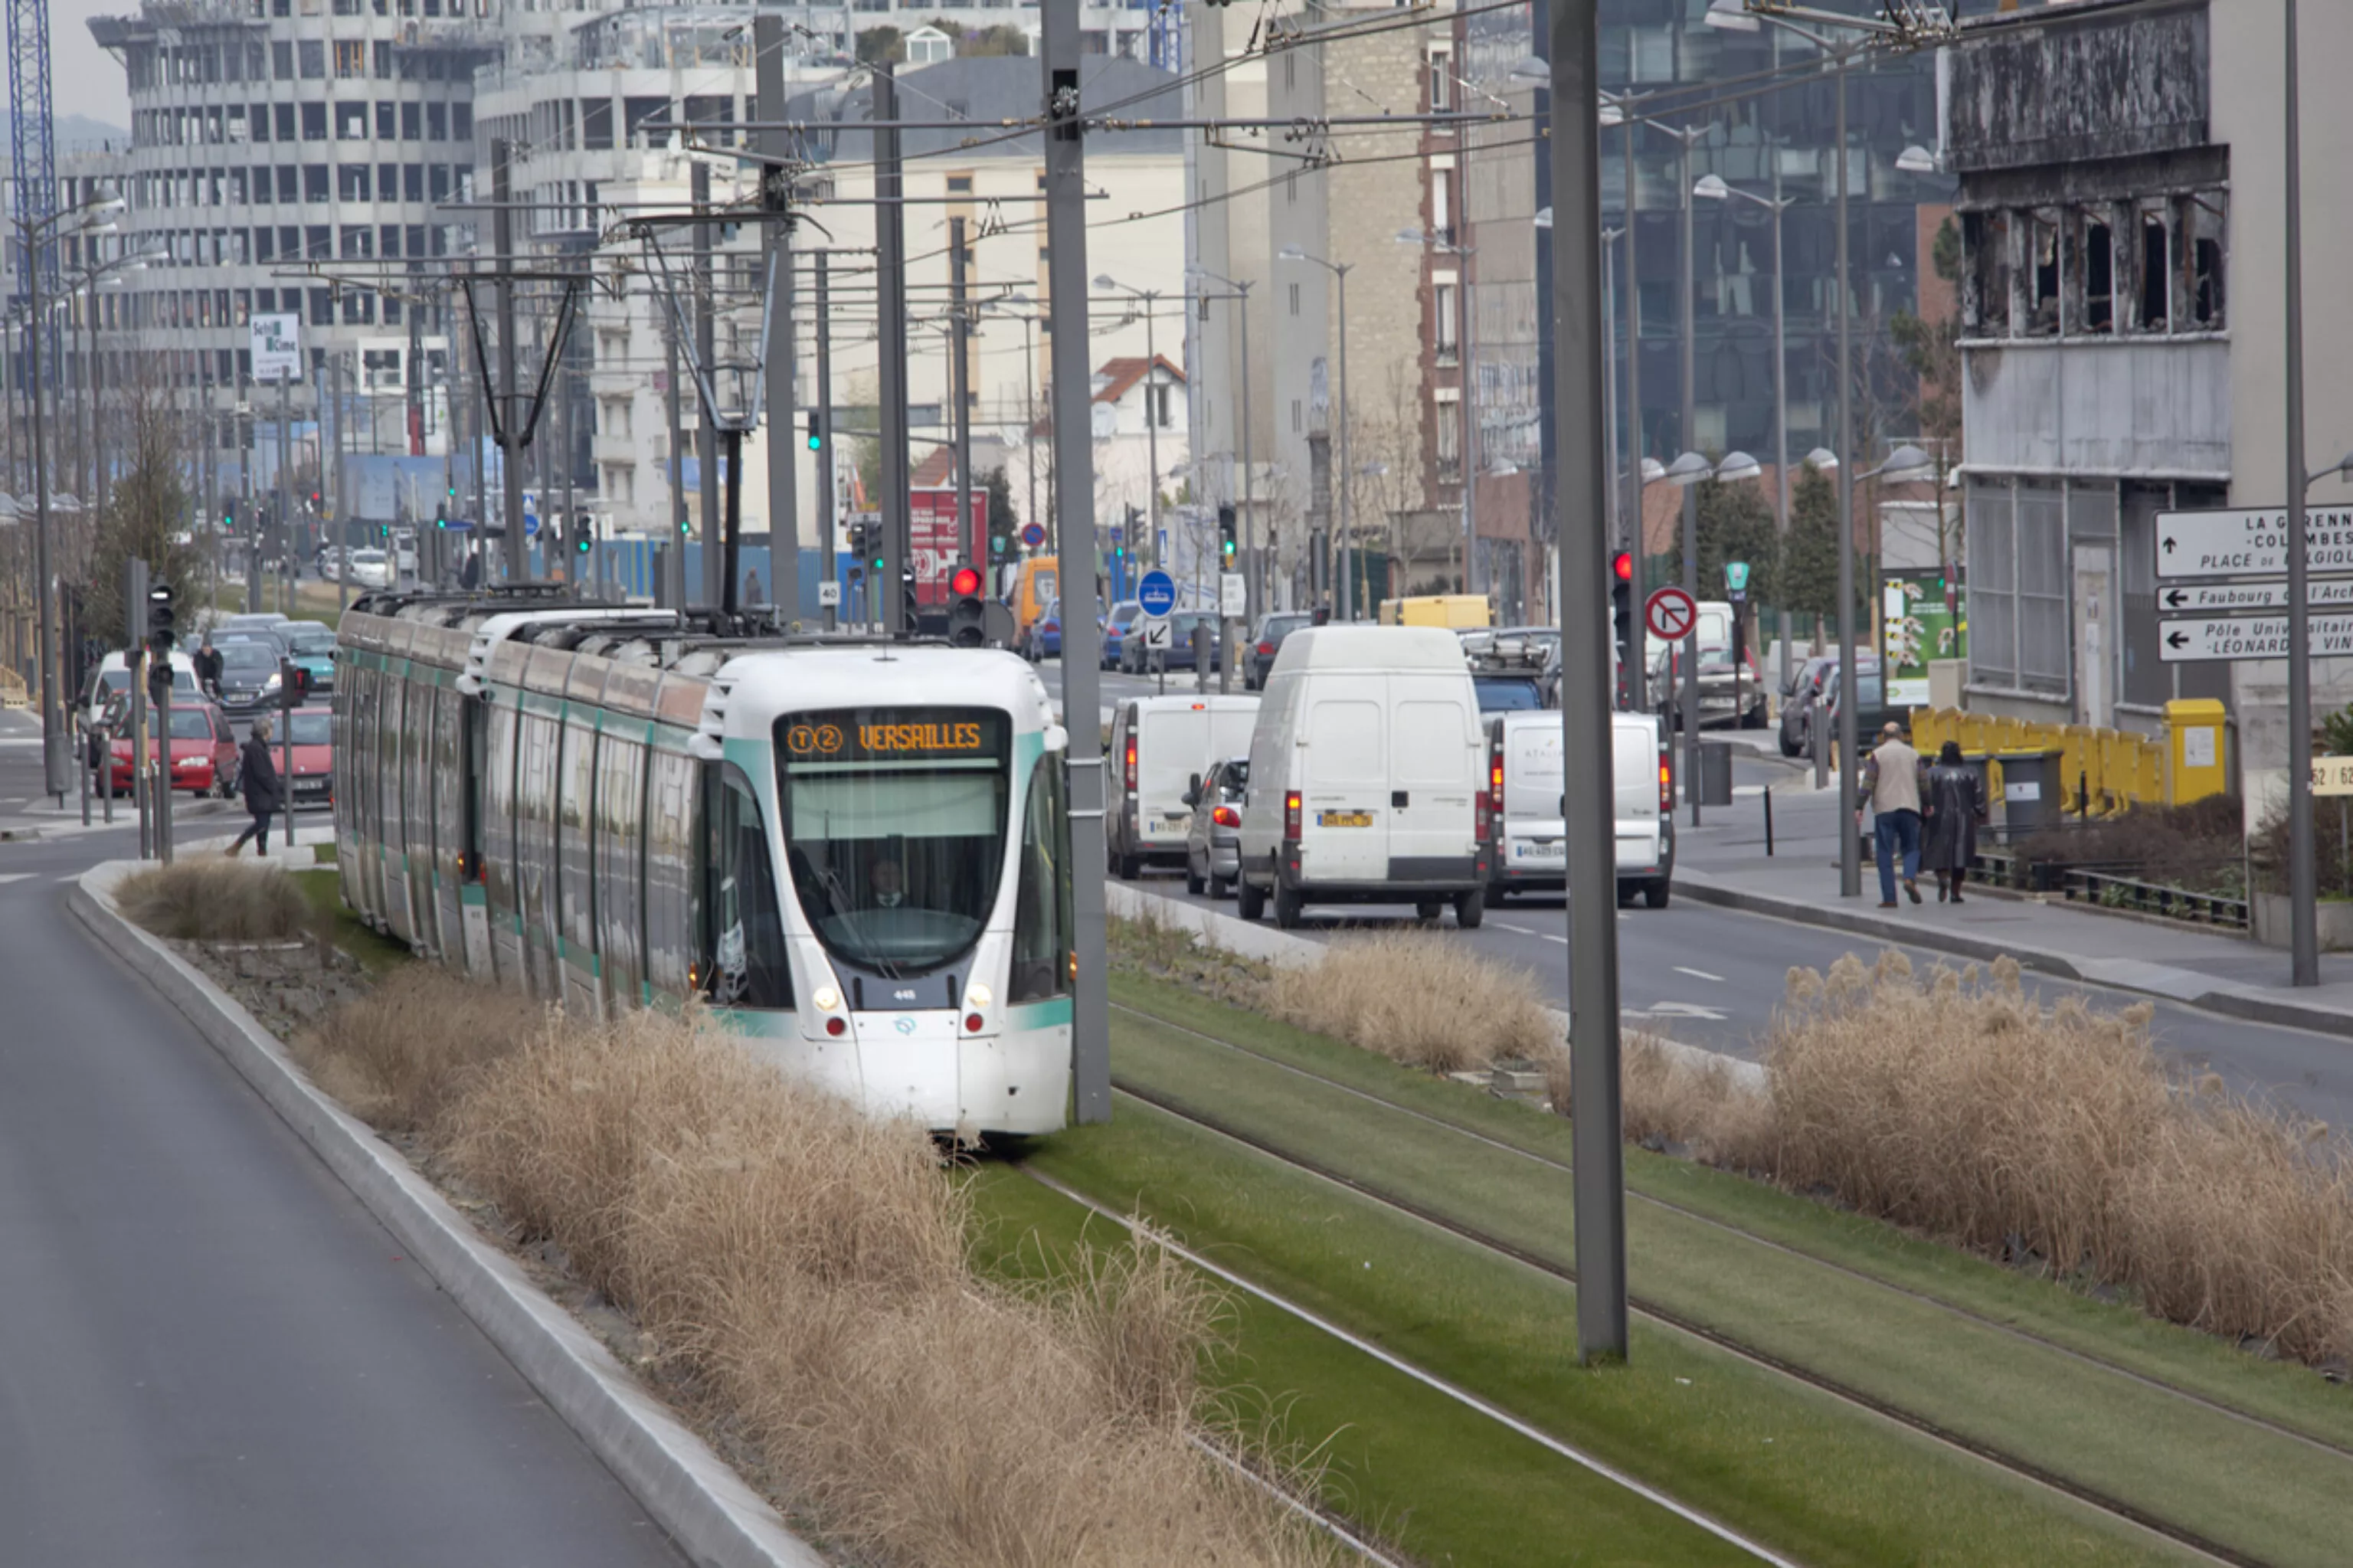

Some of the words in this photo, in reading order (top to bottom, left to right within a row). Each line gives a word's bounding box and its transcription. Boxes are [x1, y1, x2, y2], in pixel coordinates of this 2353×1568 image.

[2245, 516, 2266, 531] LA
[2276, 512, 2352, 530] GRENN
[2246, 531, 2353, 548] -COLMBES
[2201, 552, 2253, 568] PLACE
[2199, 590, 2272, 604] Faubourg
[858, 723, 981, 751] VERSAILLES
